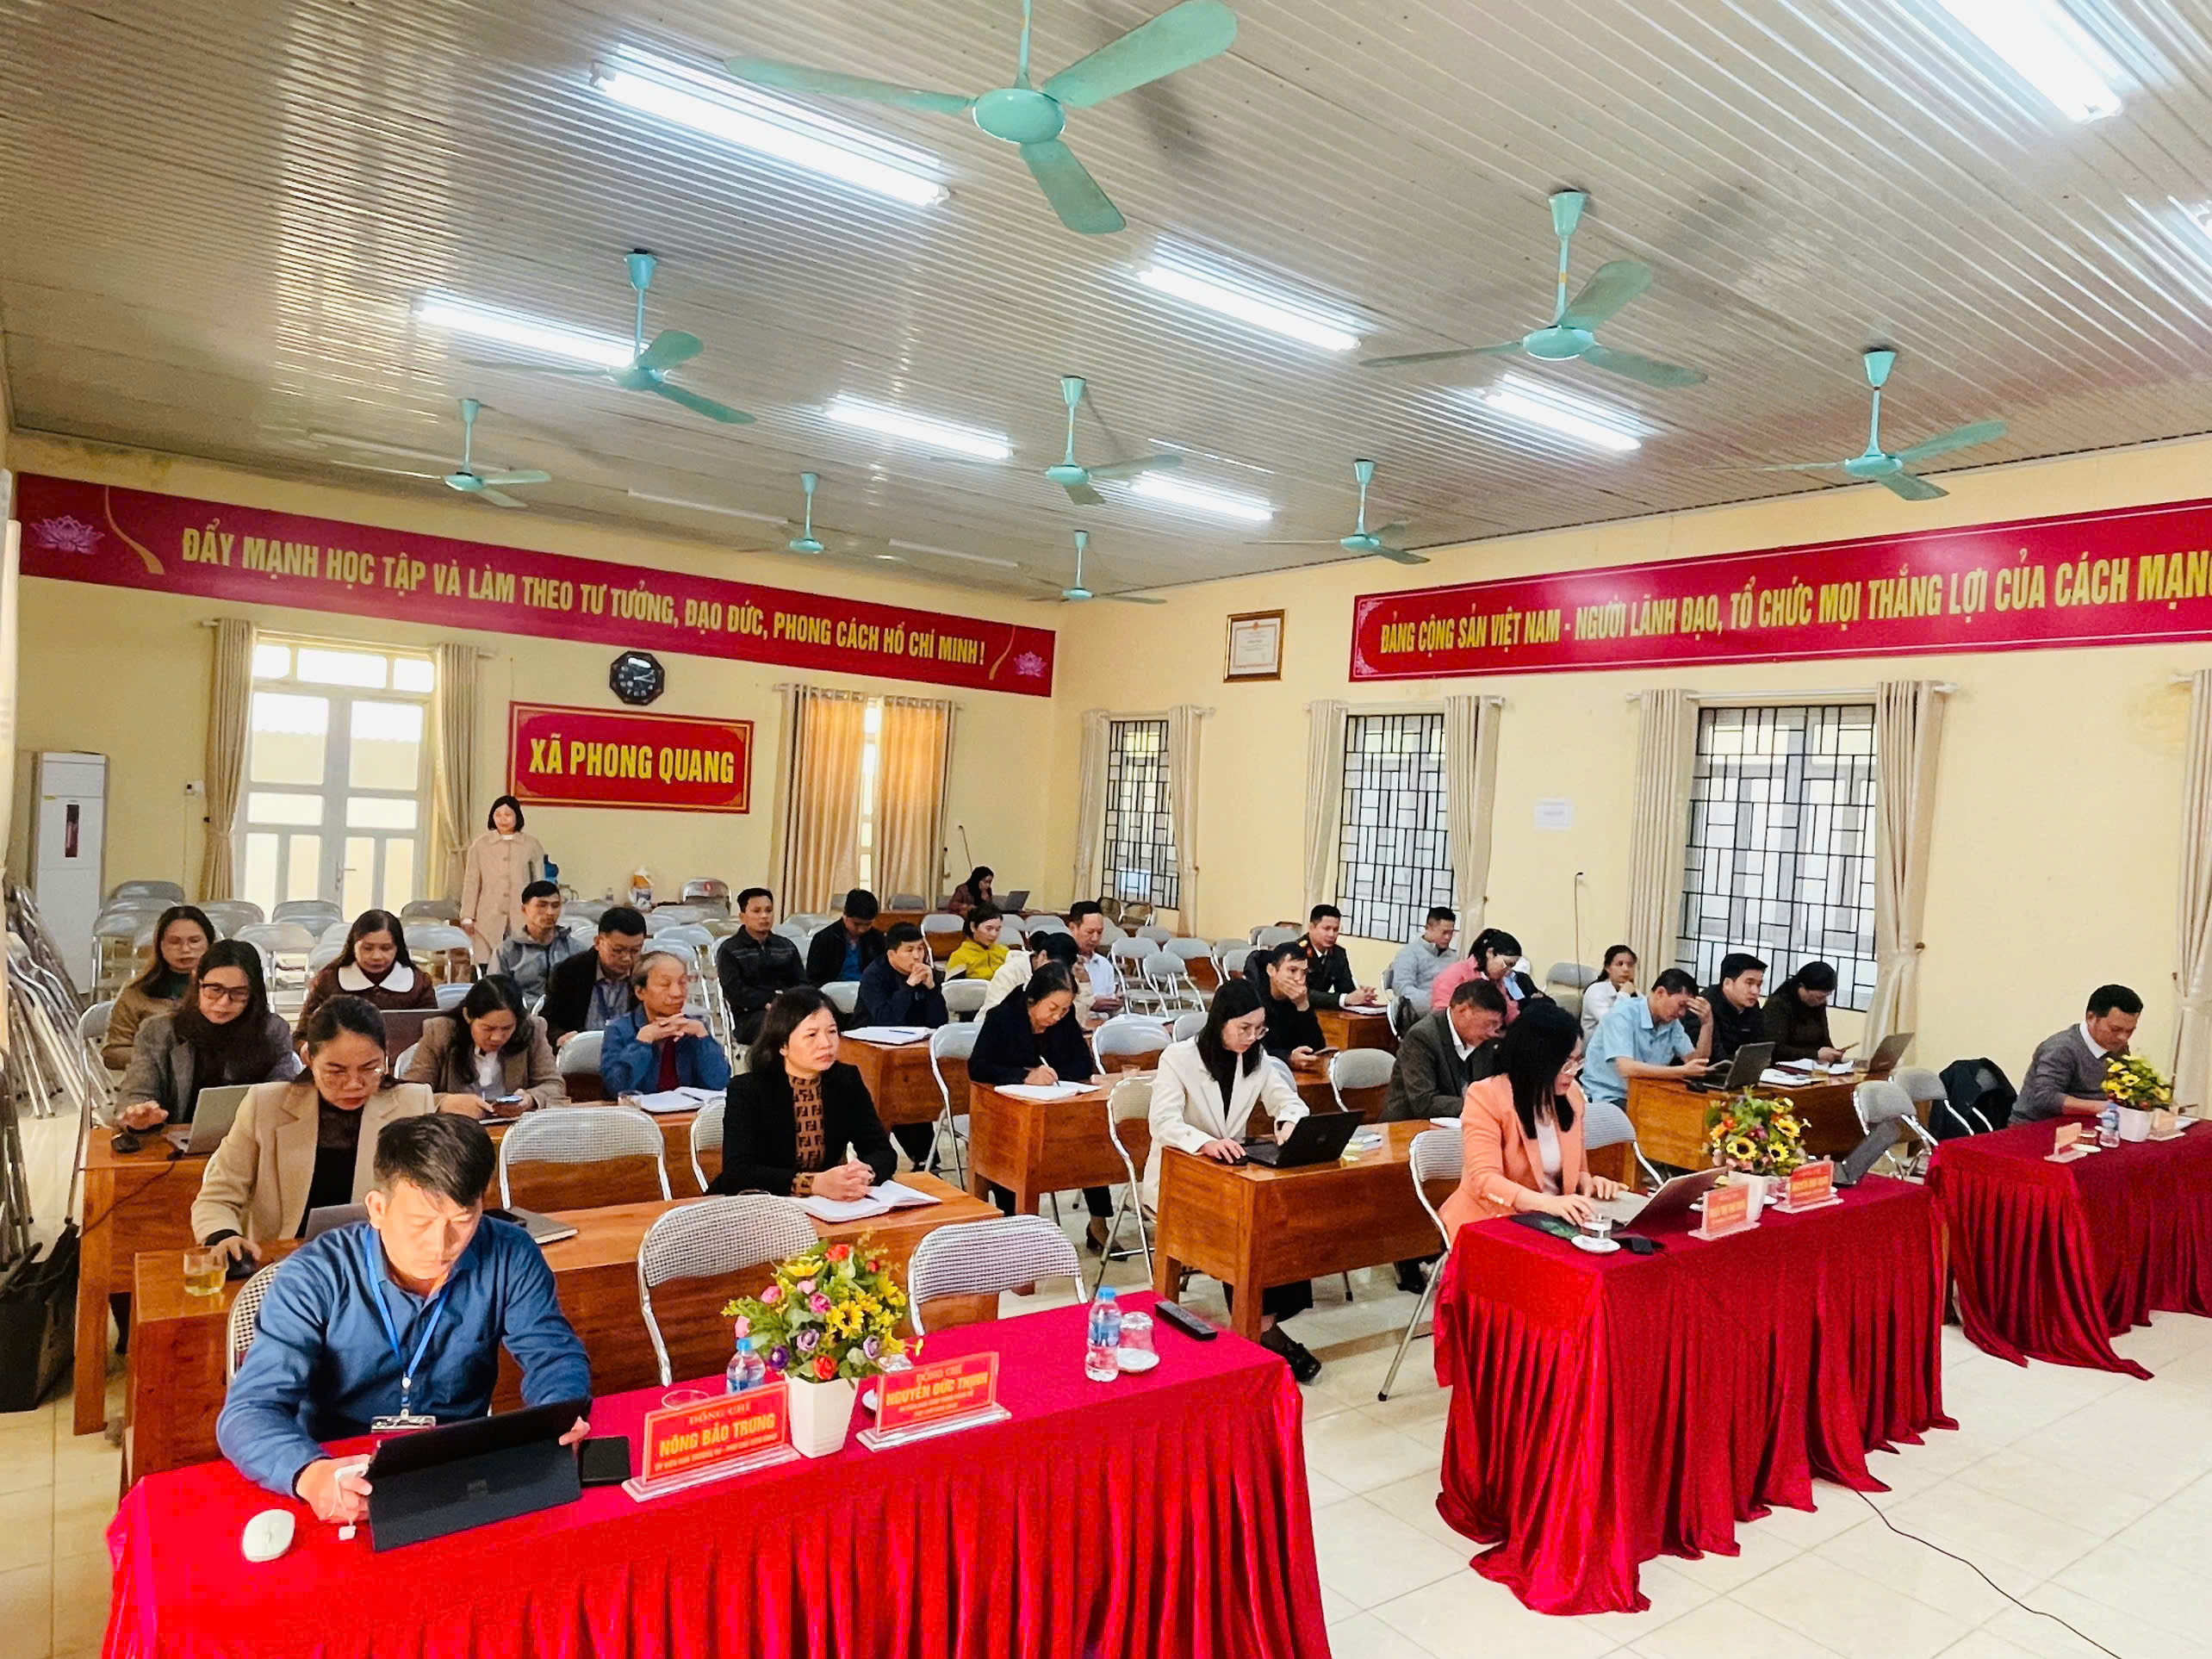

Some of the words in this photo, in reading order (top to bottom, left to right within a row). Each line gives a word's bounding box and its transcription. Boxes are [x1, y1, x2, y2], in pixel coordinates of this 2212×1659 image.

[182, 518, 235, 567] ĐẨY
[242, 536, 320, 580] MẠNH
[326, 547, 376, 590] HỌC
[382, 551, 426, 597] TẬP
[433, 558, 461, 597] VÀ
[468, 563, 515, 604] LÀM
[522, 575, 574, 612] THEO
[581, 583, 607, 615] TƯ
[611, 580, 679, 629] TƯỞNG,
[685, 599, 722, 635] ĐẠO
[727, 600, 767, 640] ĐỨC,
[773, 612, 831, 645] PHONG
[836, 617, 879, 652] CÁCH
[909, 629, 935, 658] CHÍ
[1380, 610, 1415, 654] ĐẢNG
[1418, 613, 1455, 658] CỘNG
[1457, 602, 1488, 649] SẢN
[1491, 606, 1522, 653] VIỆT
[1524, 609, 1561, 644] NAM
[1575, 594, 1627, 641] NGƯỜI
[1630, 593, 1677, 637] LÃNH
[1681, 594, 1723, 641] ĐẠO,
[1730, 575, 1756, 630] TỔ
[1758, 575, 1813, 628] CHỨC
[1818, 581, 1862, 631] MỌI
[1867, 562, 1943, 620] THẮNG
[1948, 567, 1988, 624] LỢI
[1994, 547, 2046, 612] CỦA
[2054, 551, 2130, 607] CÁCH
[2136, 550, 2212, 610] MẠN
[529, 733, 562, 774] XÃ
[569, 741, 653, 780] PHONG
[659, 747, 735, 785] QUANG
[659, 1432, 699, 1457] NÔNG
